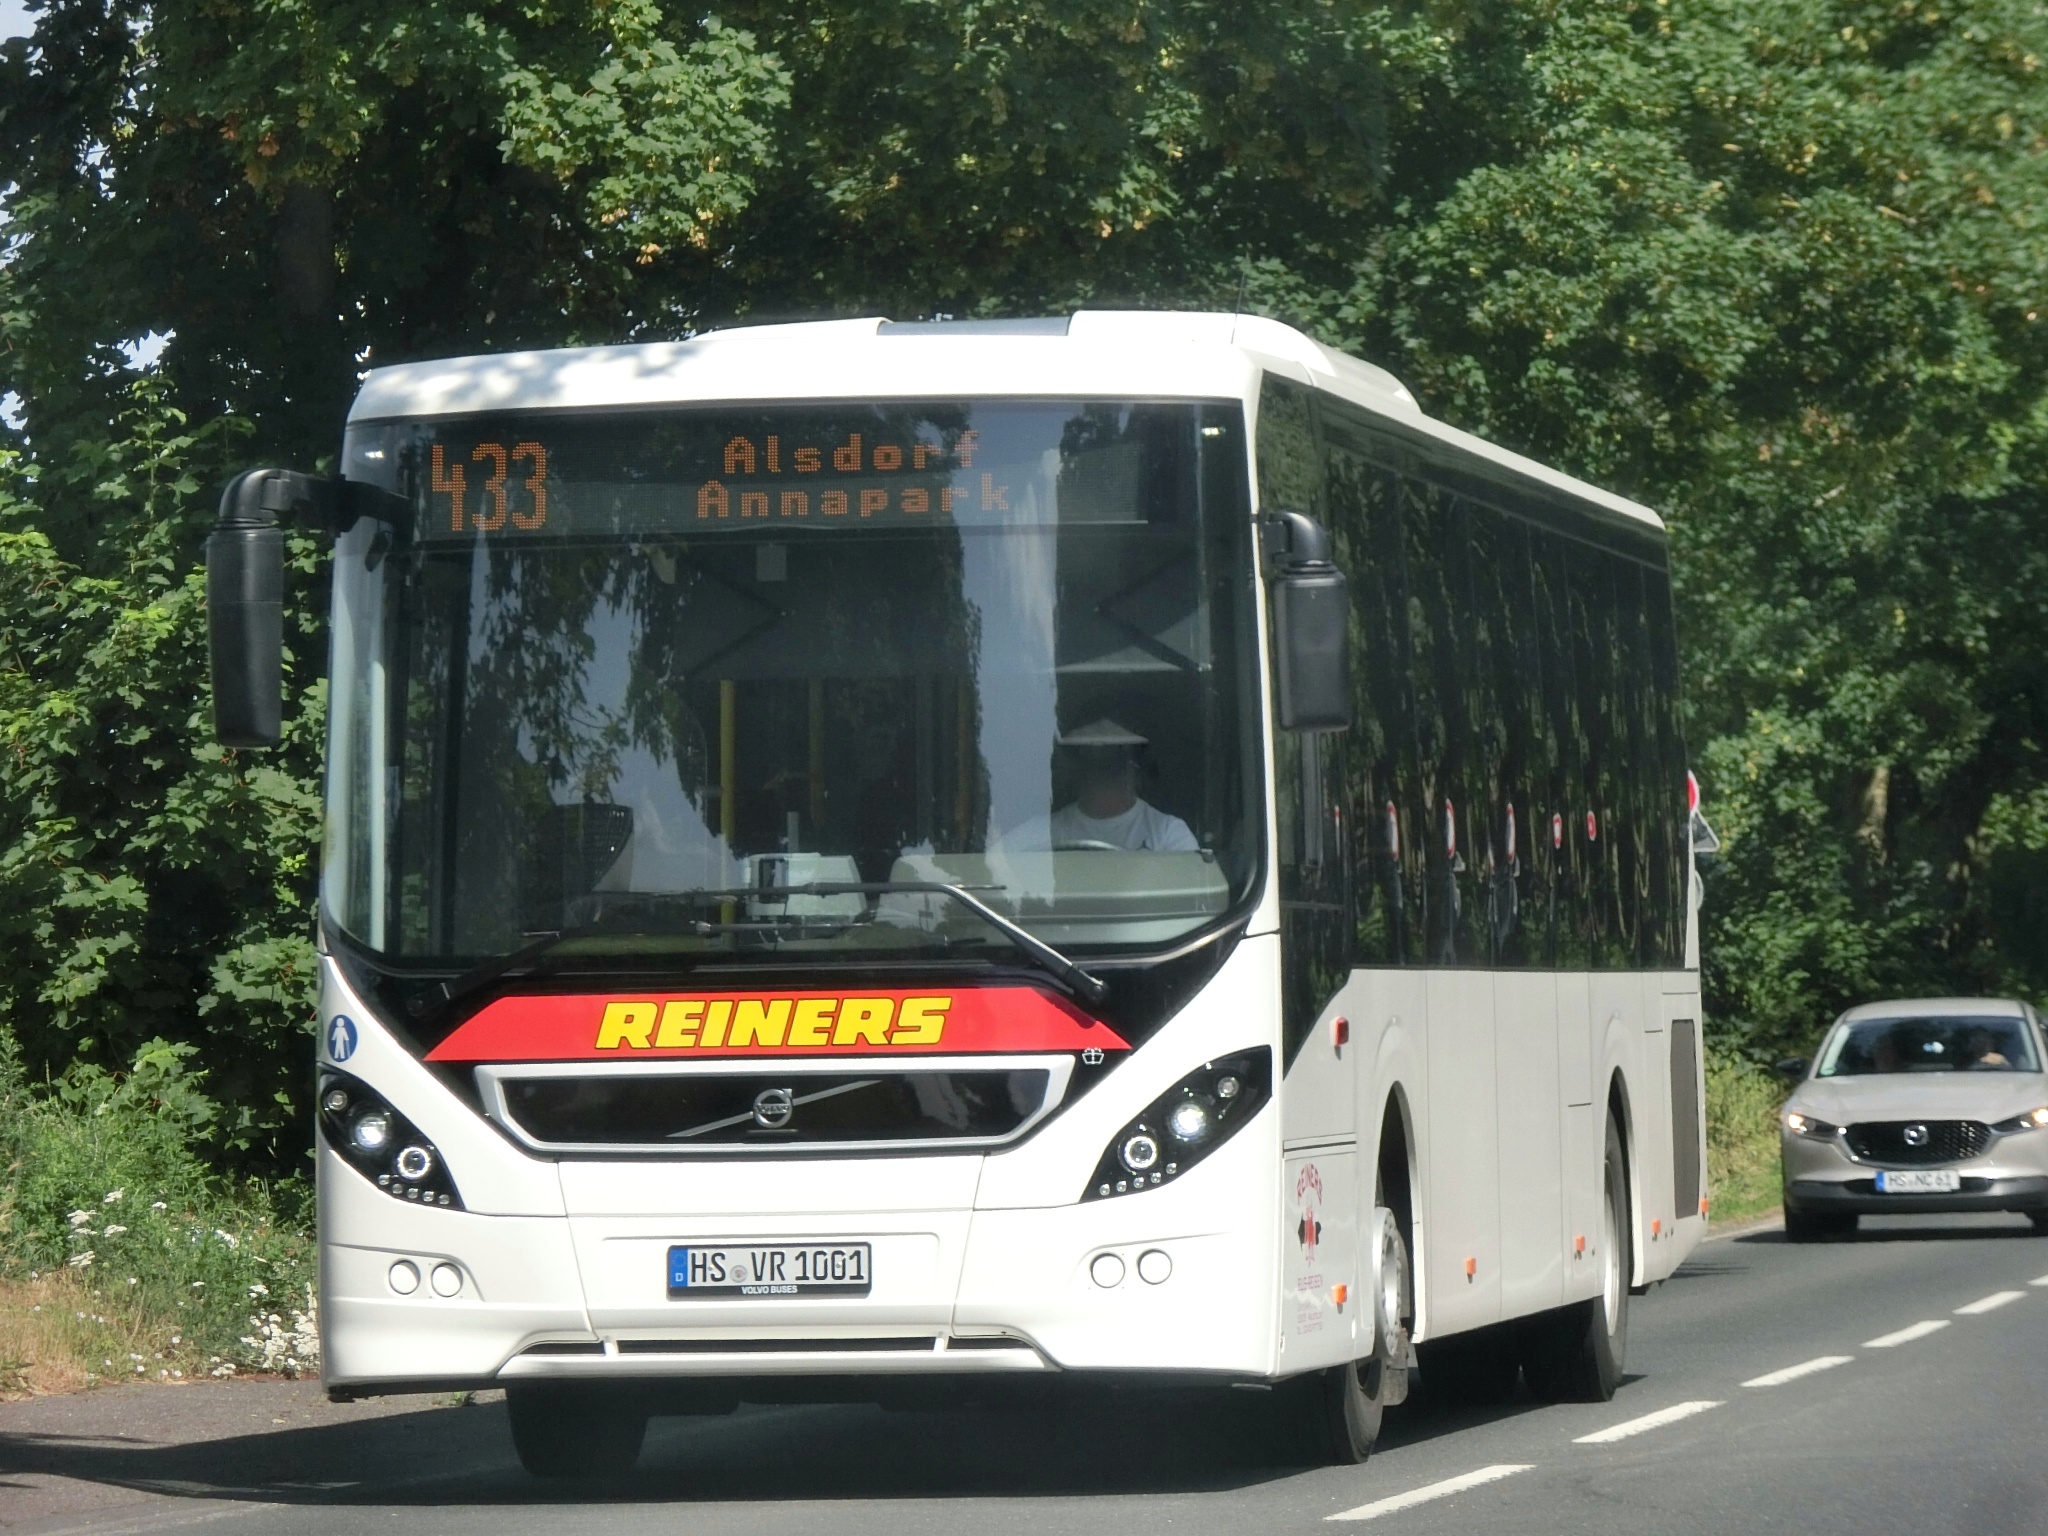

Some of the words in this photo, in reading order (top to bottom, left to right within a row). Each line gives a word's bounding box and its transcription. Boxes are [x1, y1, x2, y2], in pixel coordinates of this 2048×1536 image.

[723, 430, 979, 475] Alsdorf
[431, 442, 548, 532] 433
[697, 473, 1010, 519] Annapark
[595, 997, 952, 1049] REINERS
[1888, 1173, 1907, 1187] HS
[675, 1272, 684, 1282] D
[691, 1252, 727, 1283] HS
[751, 1251, 786, 1282] VR
[795, 1249, 865, 1281] 1001
[741, 1285, 770, 1295] VOLVO
[770, 1284, 798, 1294] BUSES
